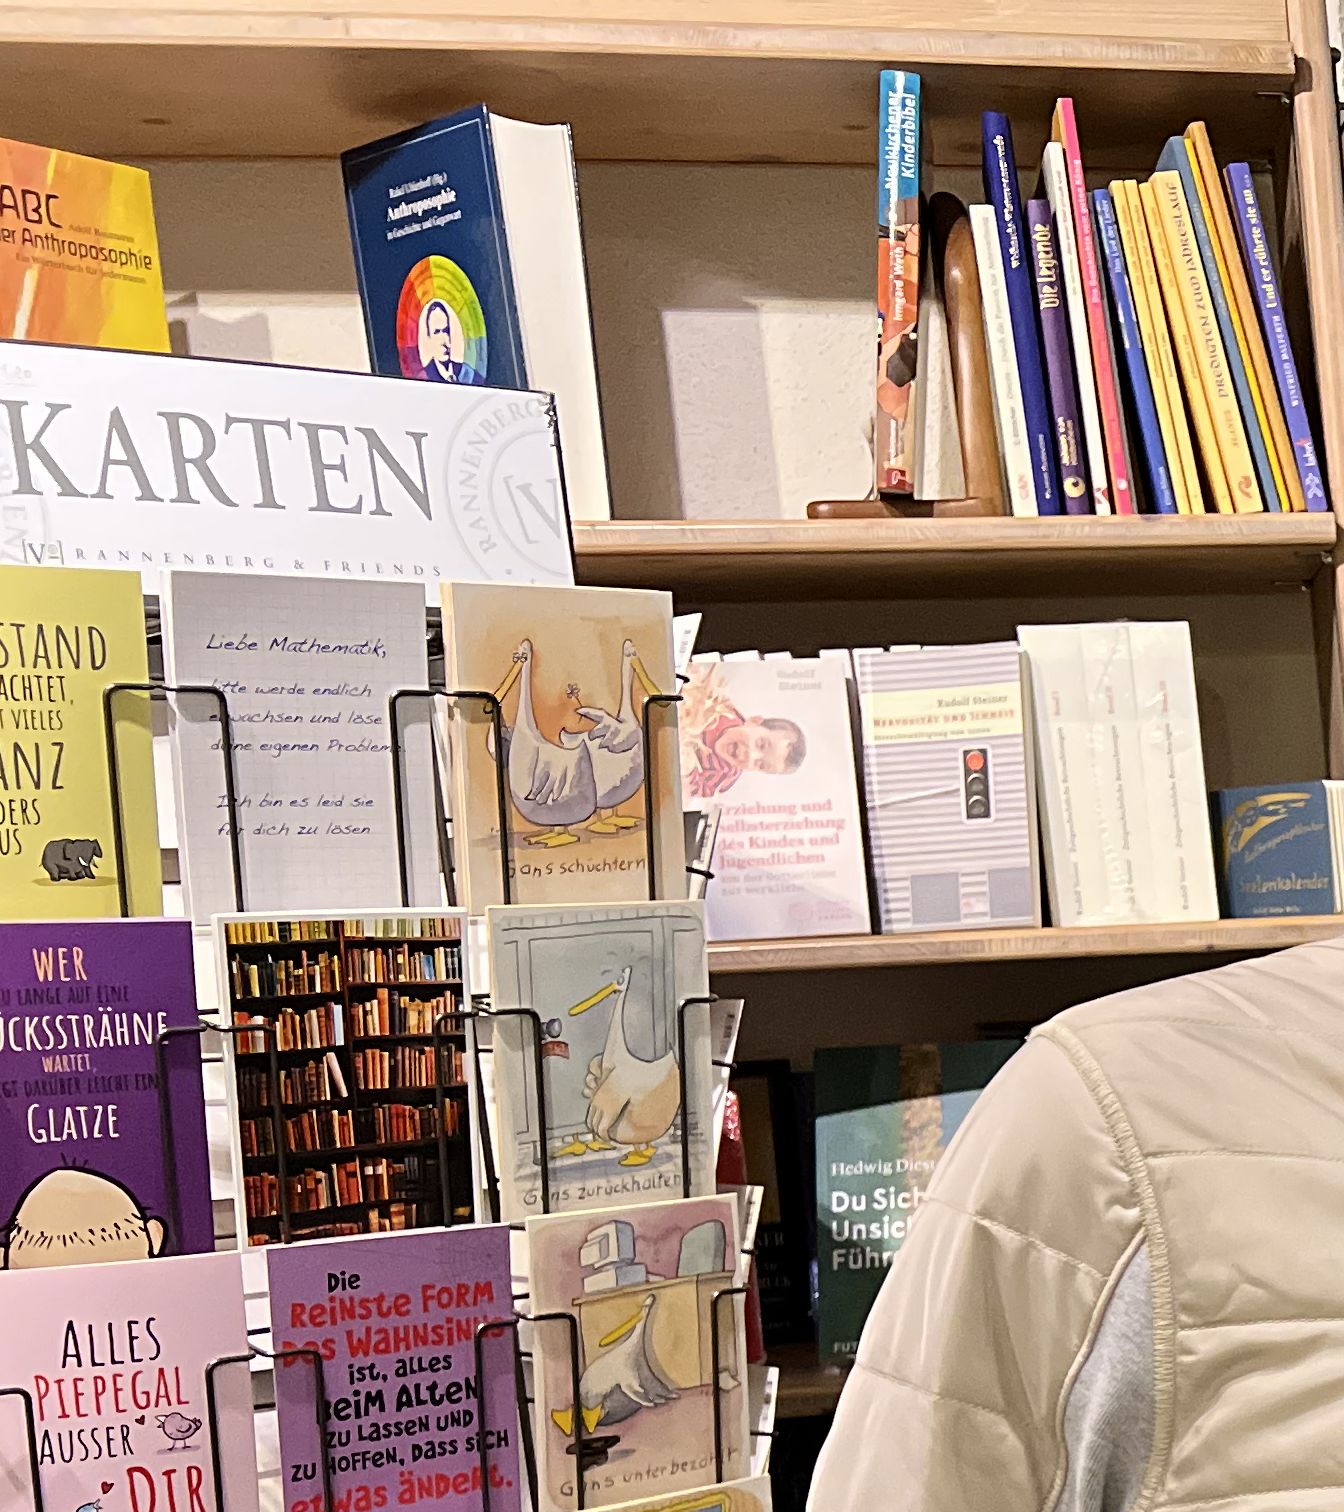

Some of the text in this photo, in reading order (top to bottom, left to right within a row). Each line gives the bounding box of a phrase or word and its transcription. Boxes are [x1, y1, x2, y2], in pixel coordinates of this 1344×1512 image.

[900, 93, 916, 178] Kinderbibel
[0, 184, 63, 228] ABC
[22, 227, 152, 271] Anthroposophie
[1251, 226, 1269, 265] rührte
[1033, 223, 1060, 310] Die Legende
[0, 400, 433, 521] KARTEN
[75, 547, 442, 578] RANNENBERG & FRIENDS
[206, 633, 388, 660] Liebe Mathematik,
[254, 681, 373, 698] werde endlich
[11, 708, 63, 731] VIELES
[309, 709, 383, 726] und löse
[259, 741, 320, 759] eigenen
[258, 792, 375, 808] bin es leid sie
[252, 820, 372, 837] dich zu lösen
[559, 855, 647, 875] schüchtern
[31, 945, 88, 983] WER
[66, 985, 91, 1004] AUF
[96, 984, 130, 1003] EINE
[24, 1073, 130, 1098] DARÜBER LEICHT
[27, 1102, 120, 1144] GLATZE
[831, 1158, 893, 1177] Hedwig
[831, 1190, 867, 1213] Du
[831, 1213, 913, 1242] Unsic
[326, 1269, 361, 1294] Die
[61, 1316, 162, 1369] ALLES
[348, 1362, 389, 1386] ist,
[33, 1365, 191, 1422] PIEPEGAL
[38, 1423, 136, 1466] AUSSER
